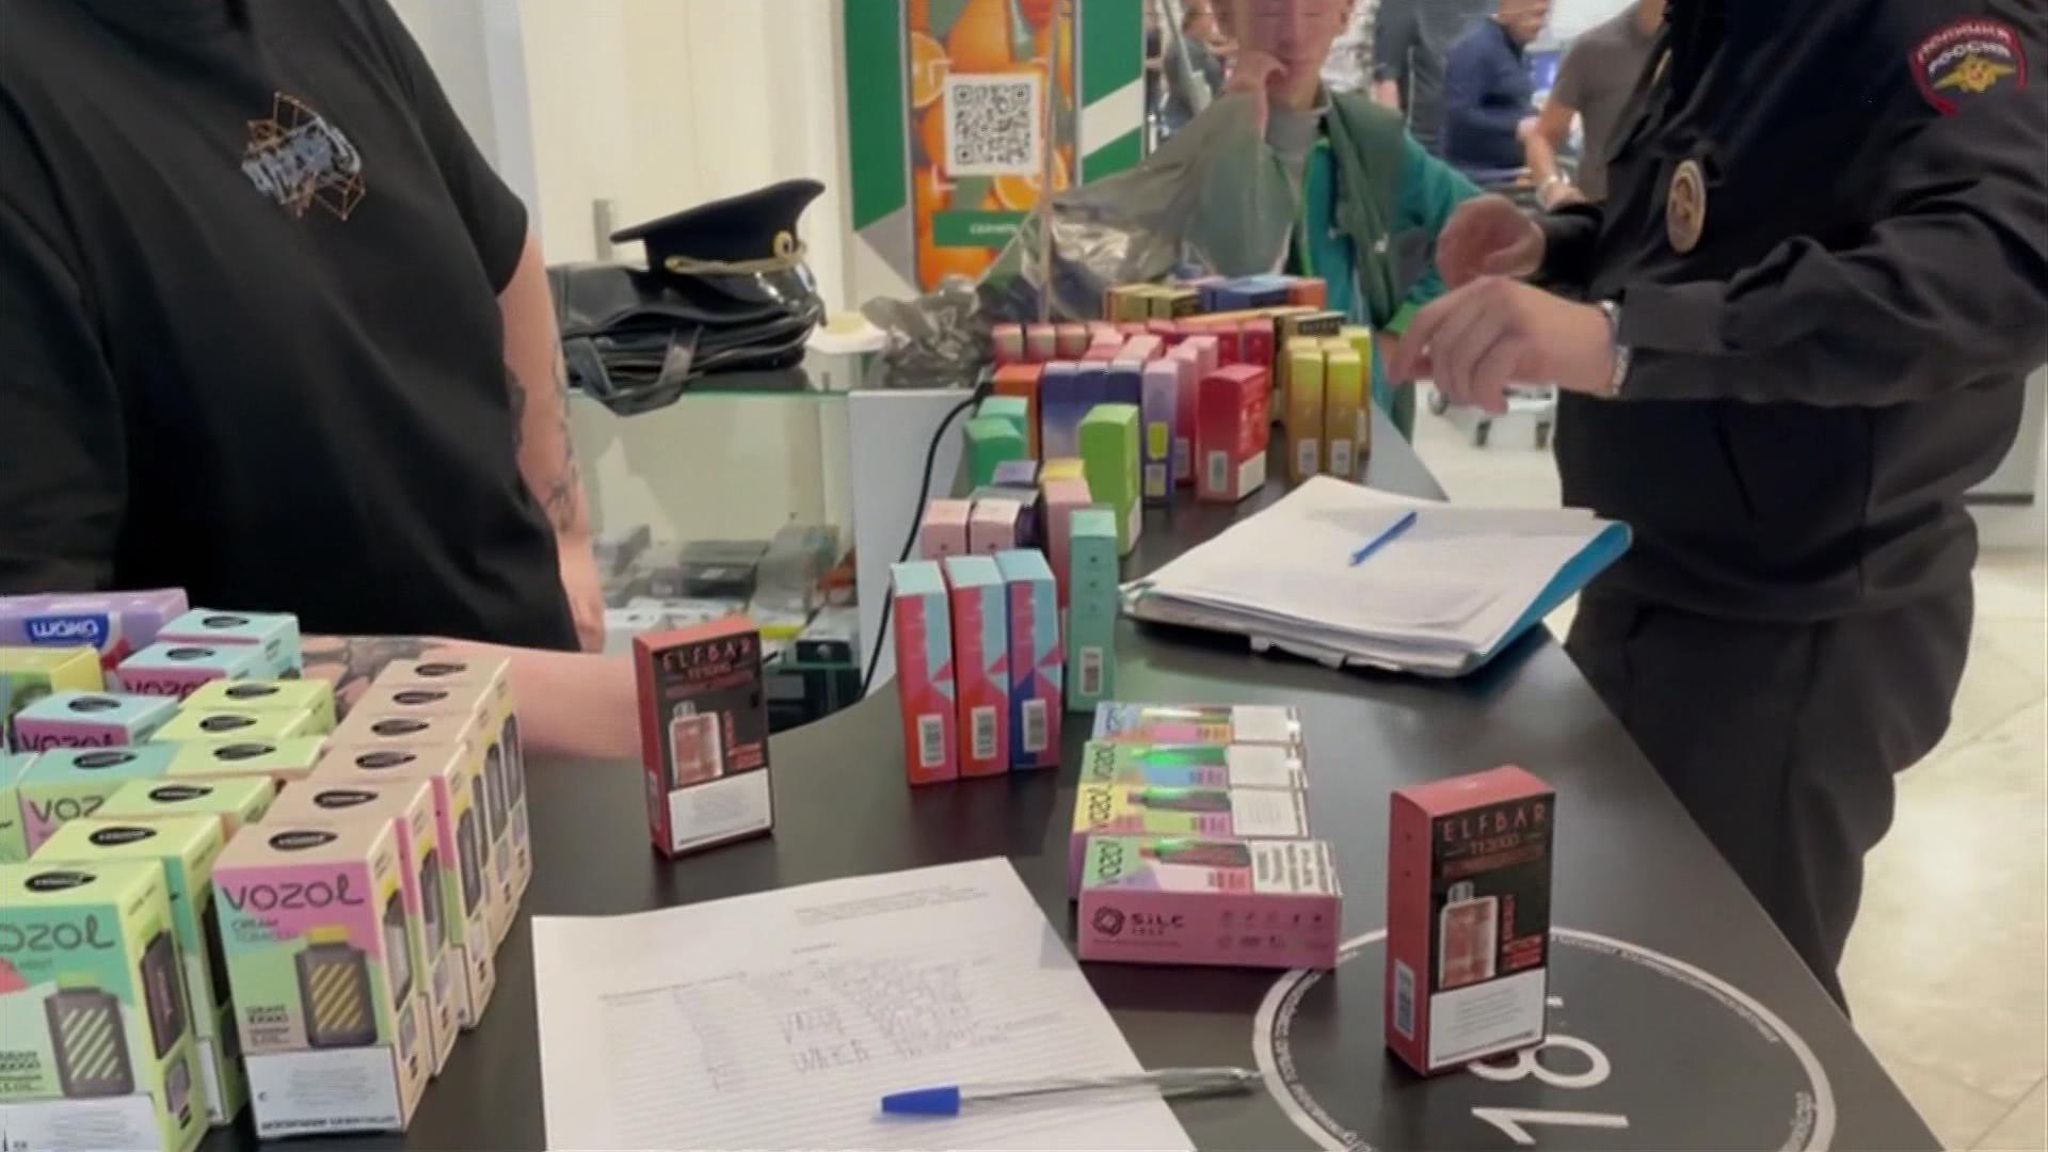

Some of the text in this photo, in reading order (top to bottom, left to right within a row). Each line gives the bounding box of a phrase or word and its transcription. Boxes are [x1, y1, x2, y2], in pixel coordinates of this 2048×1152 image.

[1928, 40, 2012, 77] РОССИЯ
[1442, 803, 1547, 842] ELFBAR
[222, 873, 366, 911] VOZOL
[0, 914, 115, 951] OZOL
